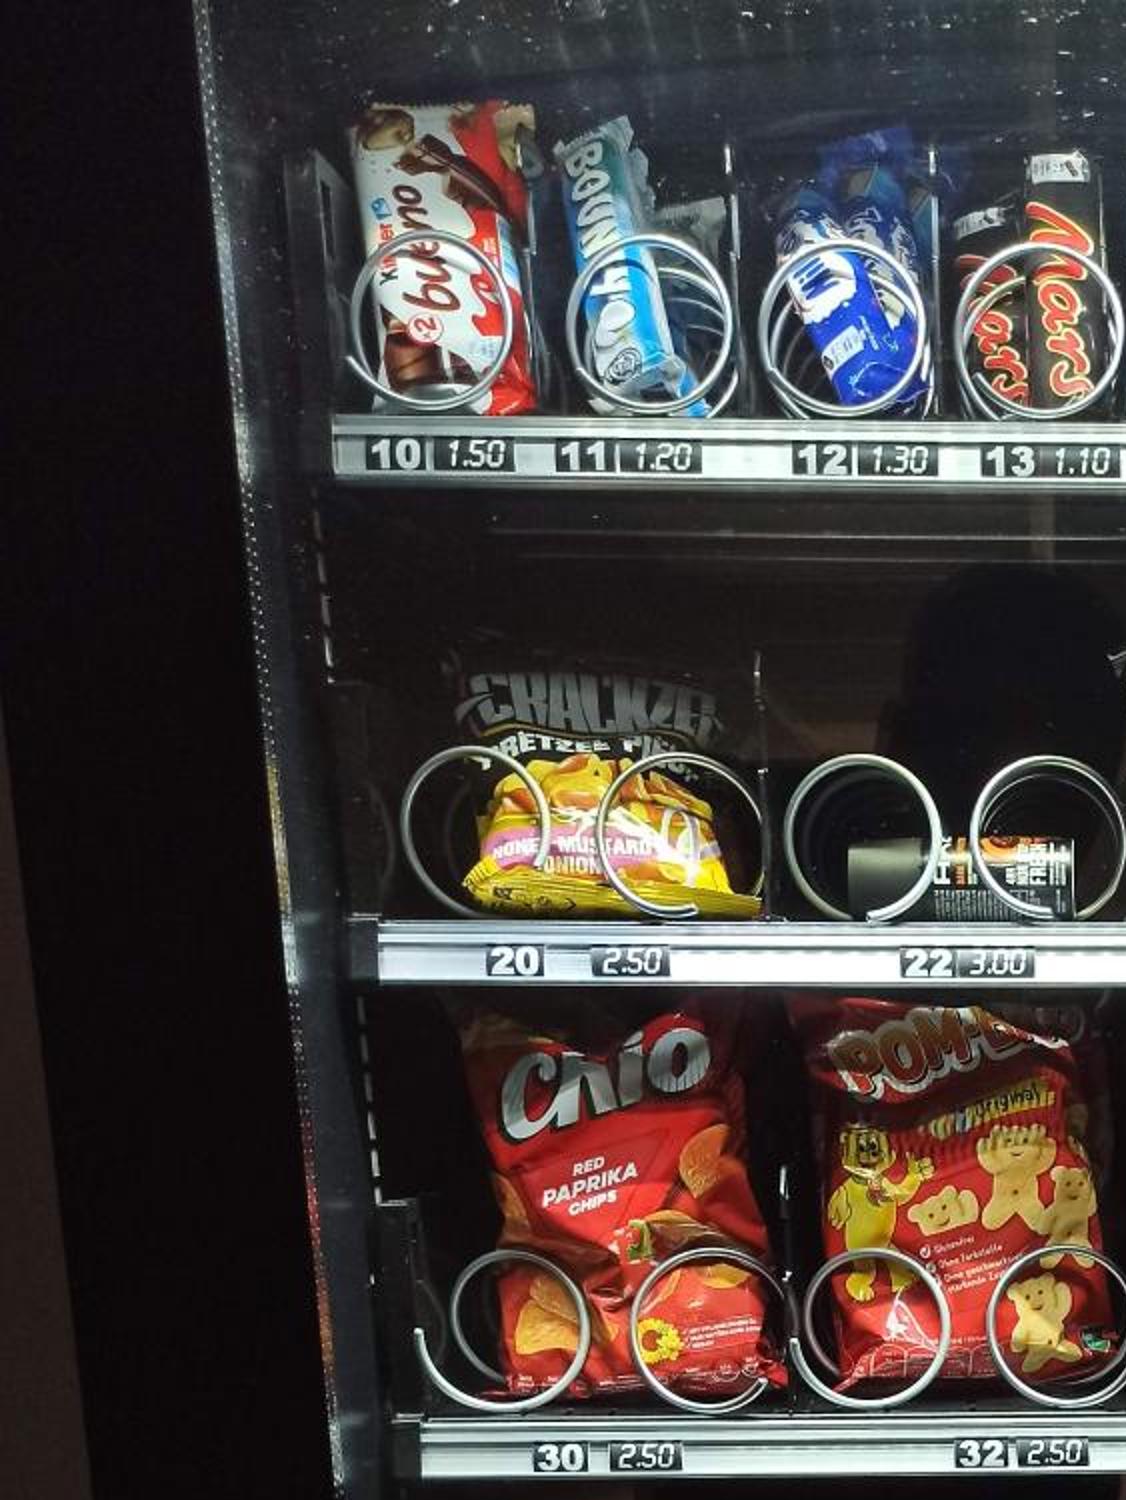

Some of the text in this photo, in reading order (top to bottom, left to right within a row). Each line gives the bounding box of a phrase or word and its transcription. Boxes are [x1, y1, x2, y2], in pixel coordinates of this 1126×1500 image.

[379, 222, 398, 287] Kiner
[371, 439, 506, 470] 10 1.50
[561, 440, 694, 471] 11 1.20
[798, 445, 929, 475] 12 1.30
[985, 446, 1112, 476] 13 1.10
[490, 947, 664, 977] 20 2.50
[904, 947, 1028, 978] 22 3.00
[502, 1027, 713, 1142] Chio
[572, 1156, 606, 1177] RED
[543, 1162, 639, 1209] PAPRIKA
[568, 1189, 618, 1217] CHIPS
[537, 1443, 676, 1472] 30 2.50
[958, 1438, 1084, 1468] 32 2.50
